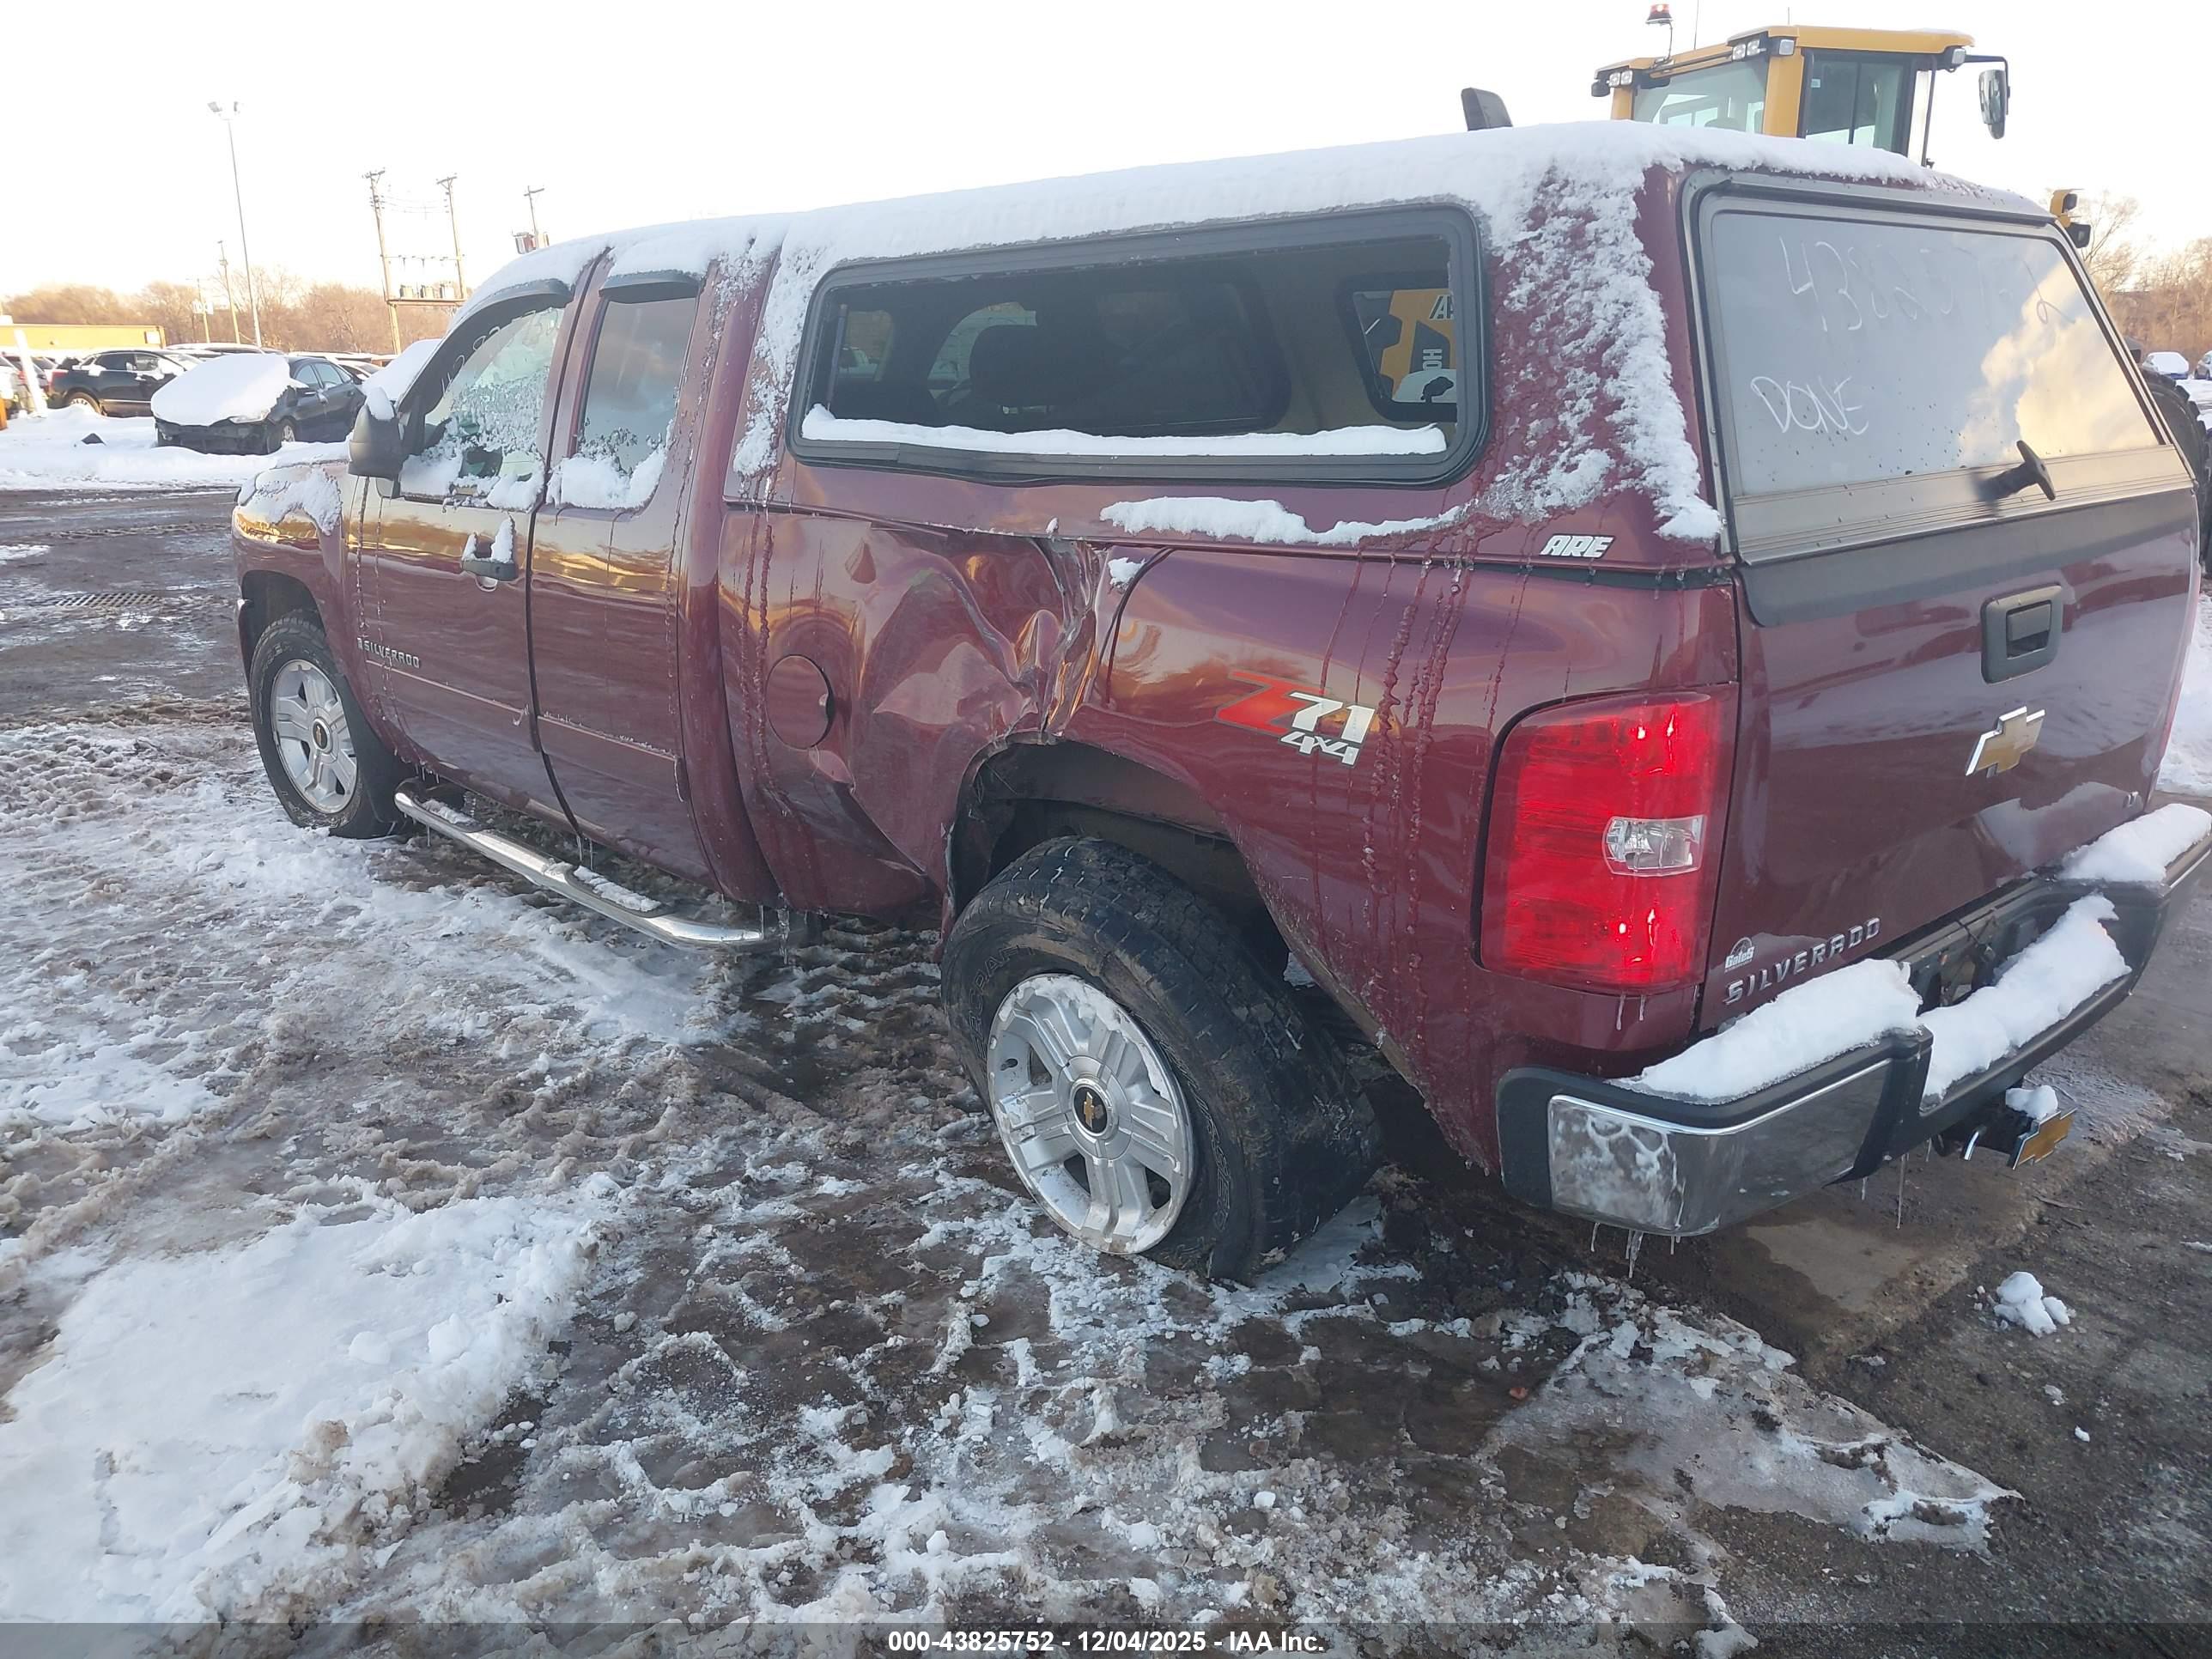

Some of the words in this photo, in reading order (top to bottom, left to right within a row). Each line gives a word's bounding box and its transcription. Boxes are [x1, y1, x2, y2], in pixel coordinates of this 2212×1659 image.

[1751, 376, 1869, 435] DONE
[1540, 534, 1614, 558] ARE
[364, 640, 421, 669] SILVERADO
[1217, 671, 1376, 744] Z71
[1723, 916, 1881, 1006] SILVERADO
